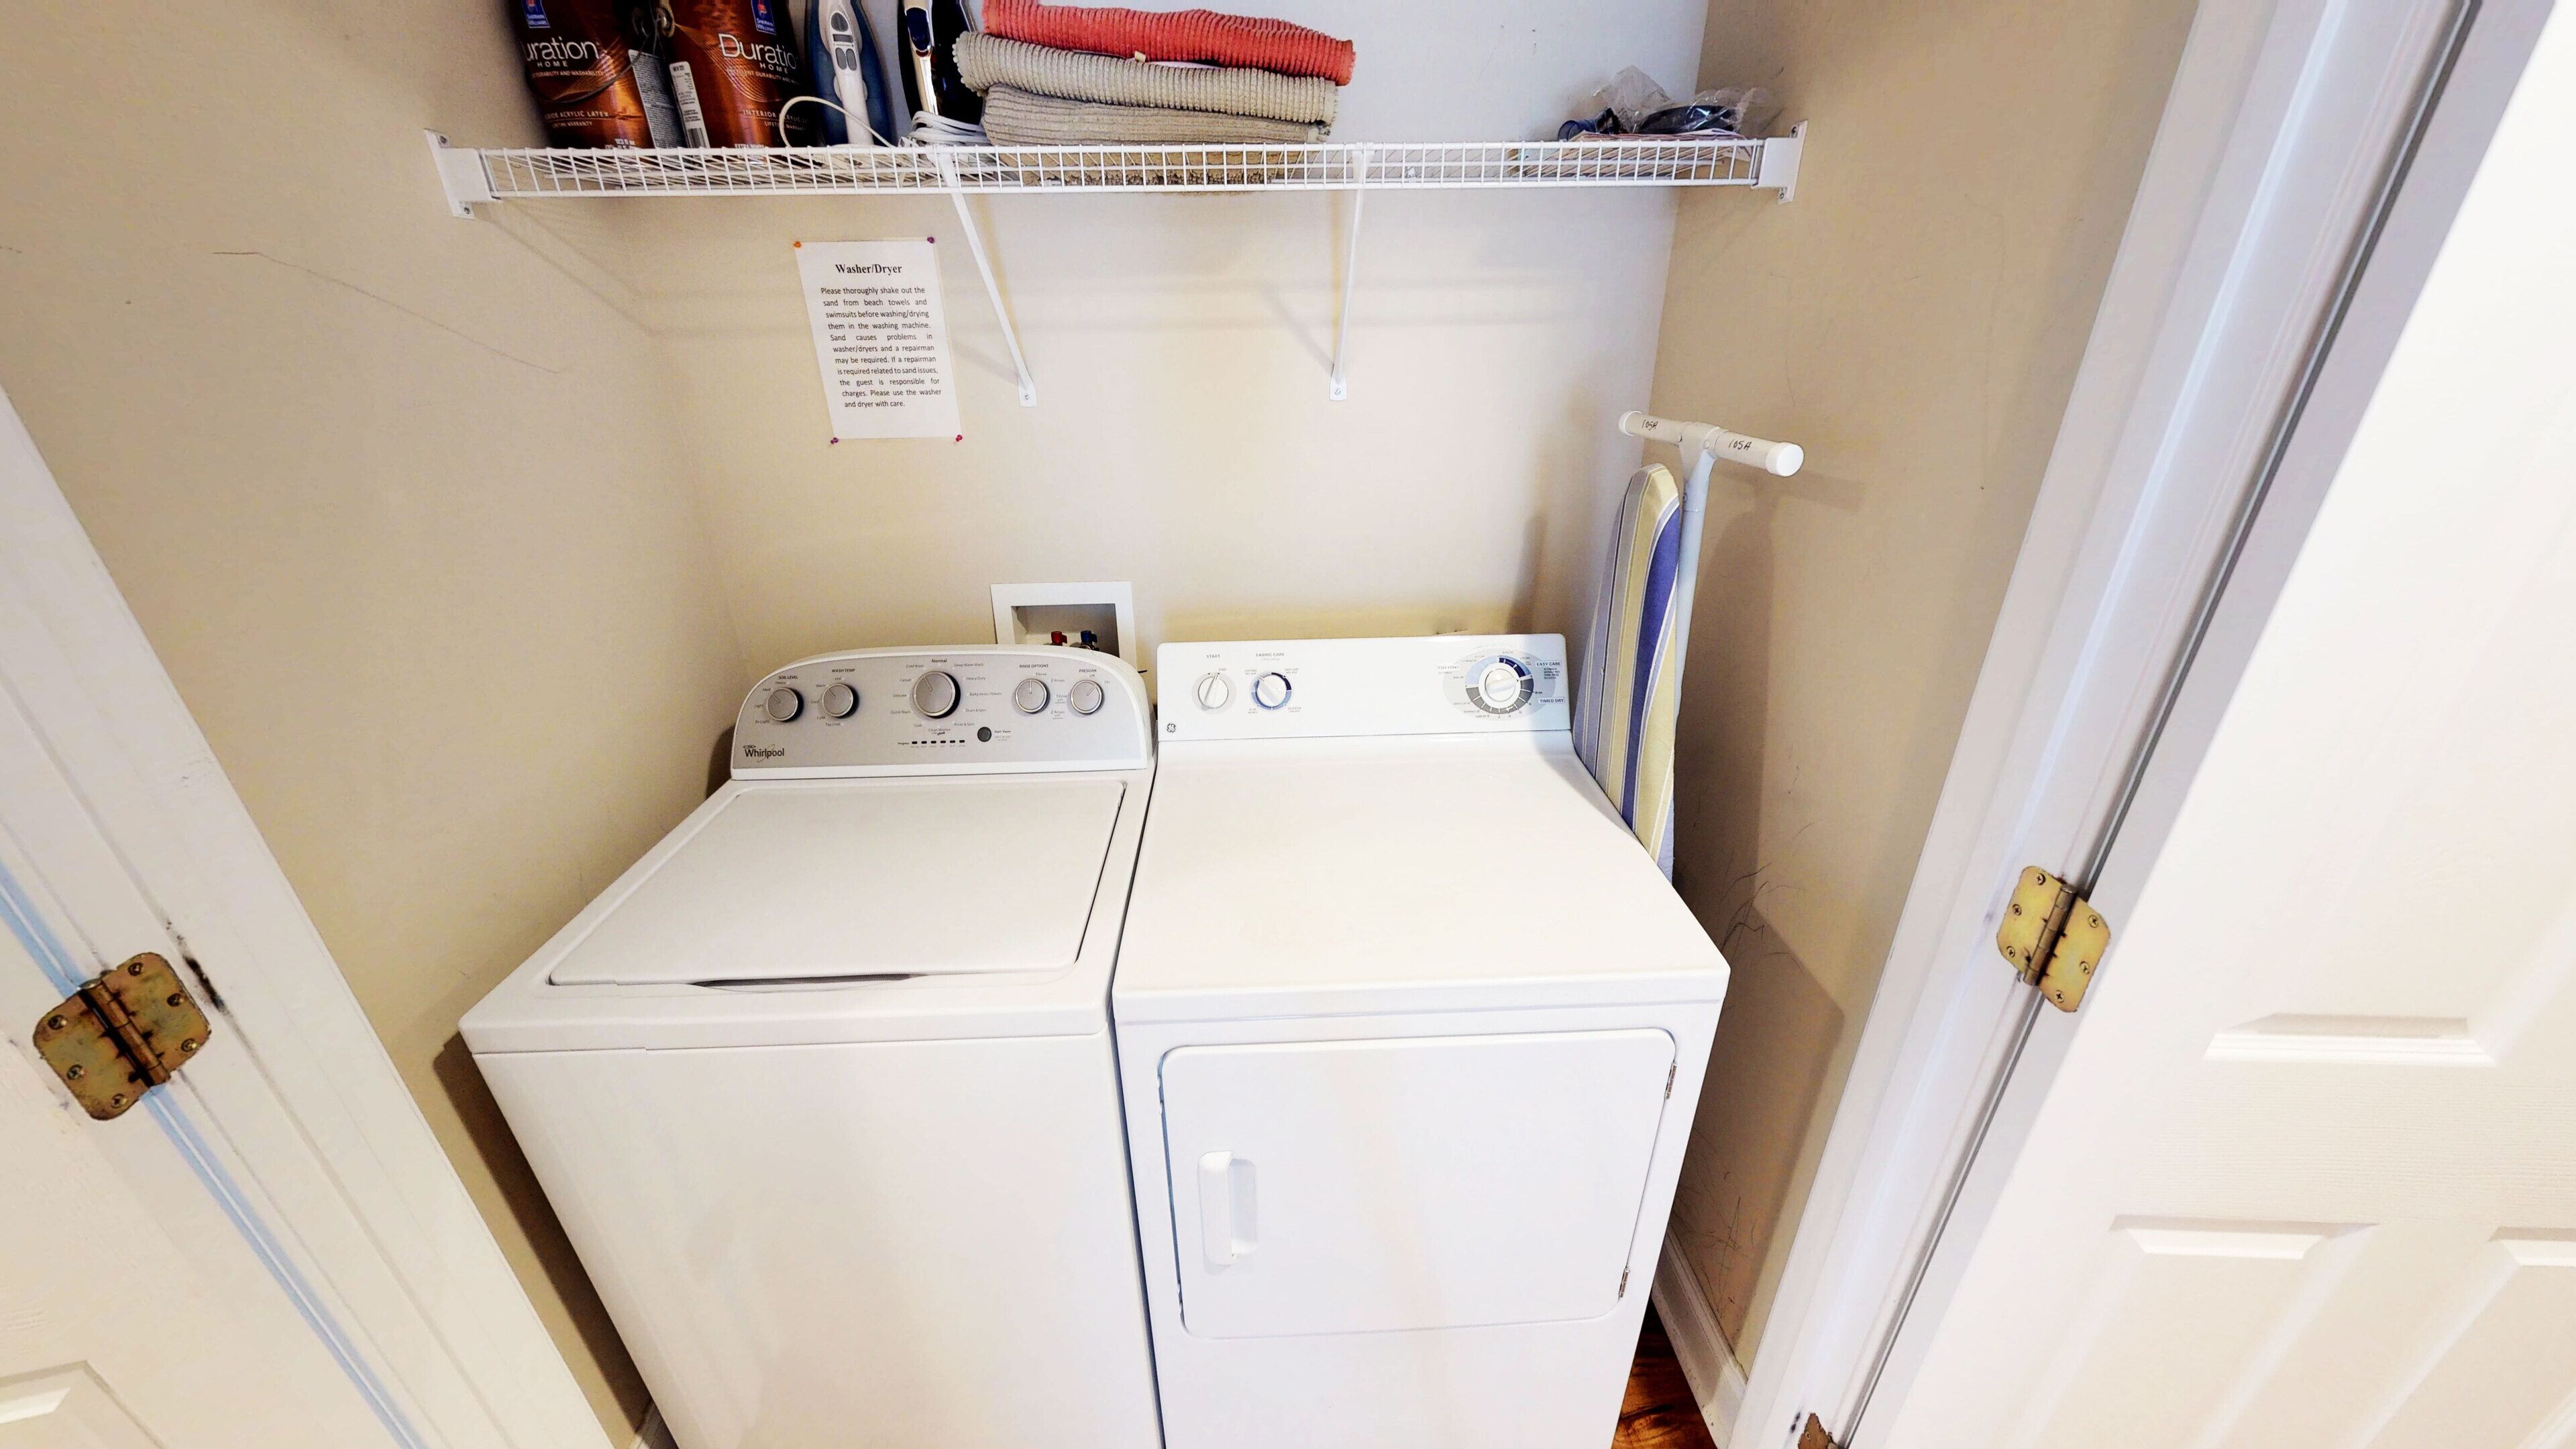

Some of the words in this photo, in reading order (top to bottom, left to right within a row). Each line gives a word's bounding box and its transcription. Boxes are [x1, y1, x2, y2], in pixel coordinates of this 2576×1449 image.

[527, 36, 600, 60] uration
[718, 34, 796, 69] Duratio
[760, 63, 788, 74] HOME
[743, 109, 776, 117] INTERIOR
[835, 264, 902, 275] Washer/Dryer
[843, 287, 878, 295] thoroughly
[880, 311, 929, 319] washing/drying
[745, 748, 784, 759] Whirlpool
